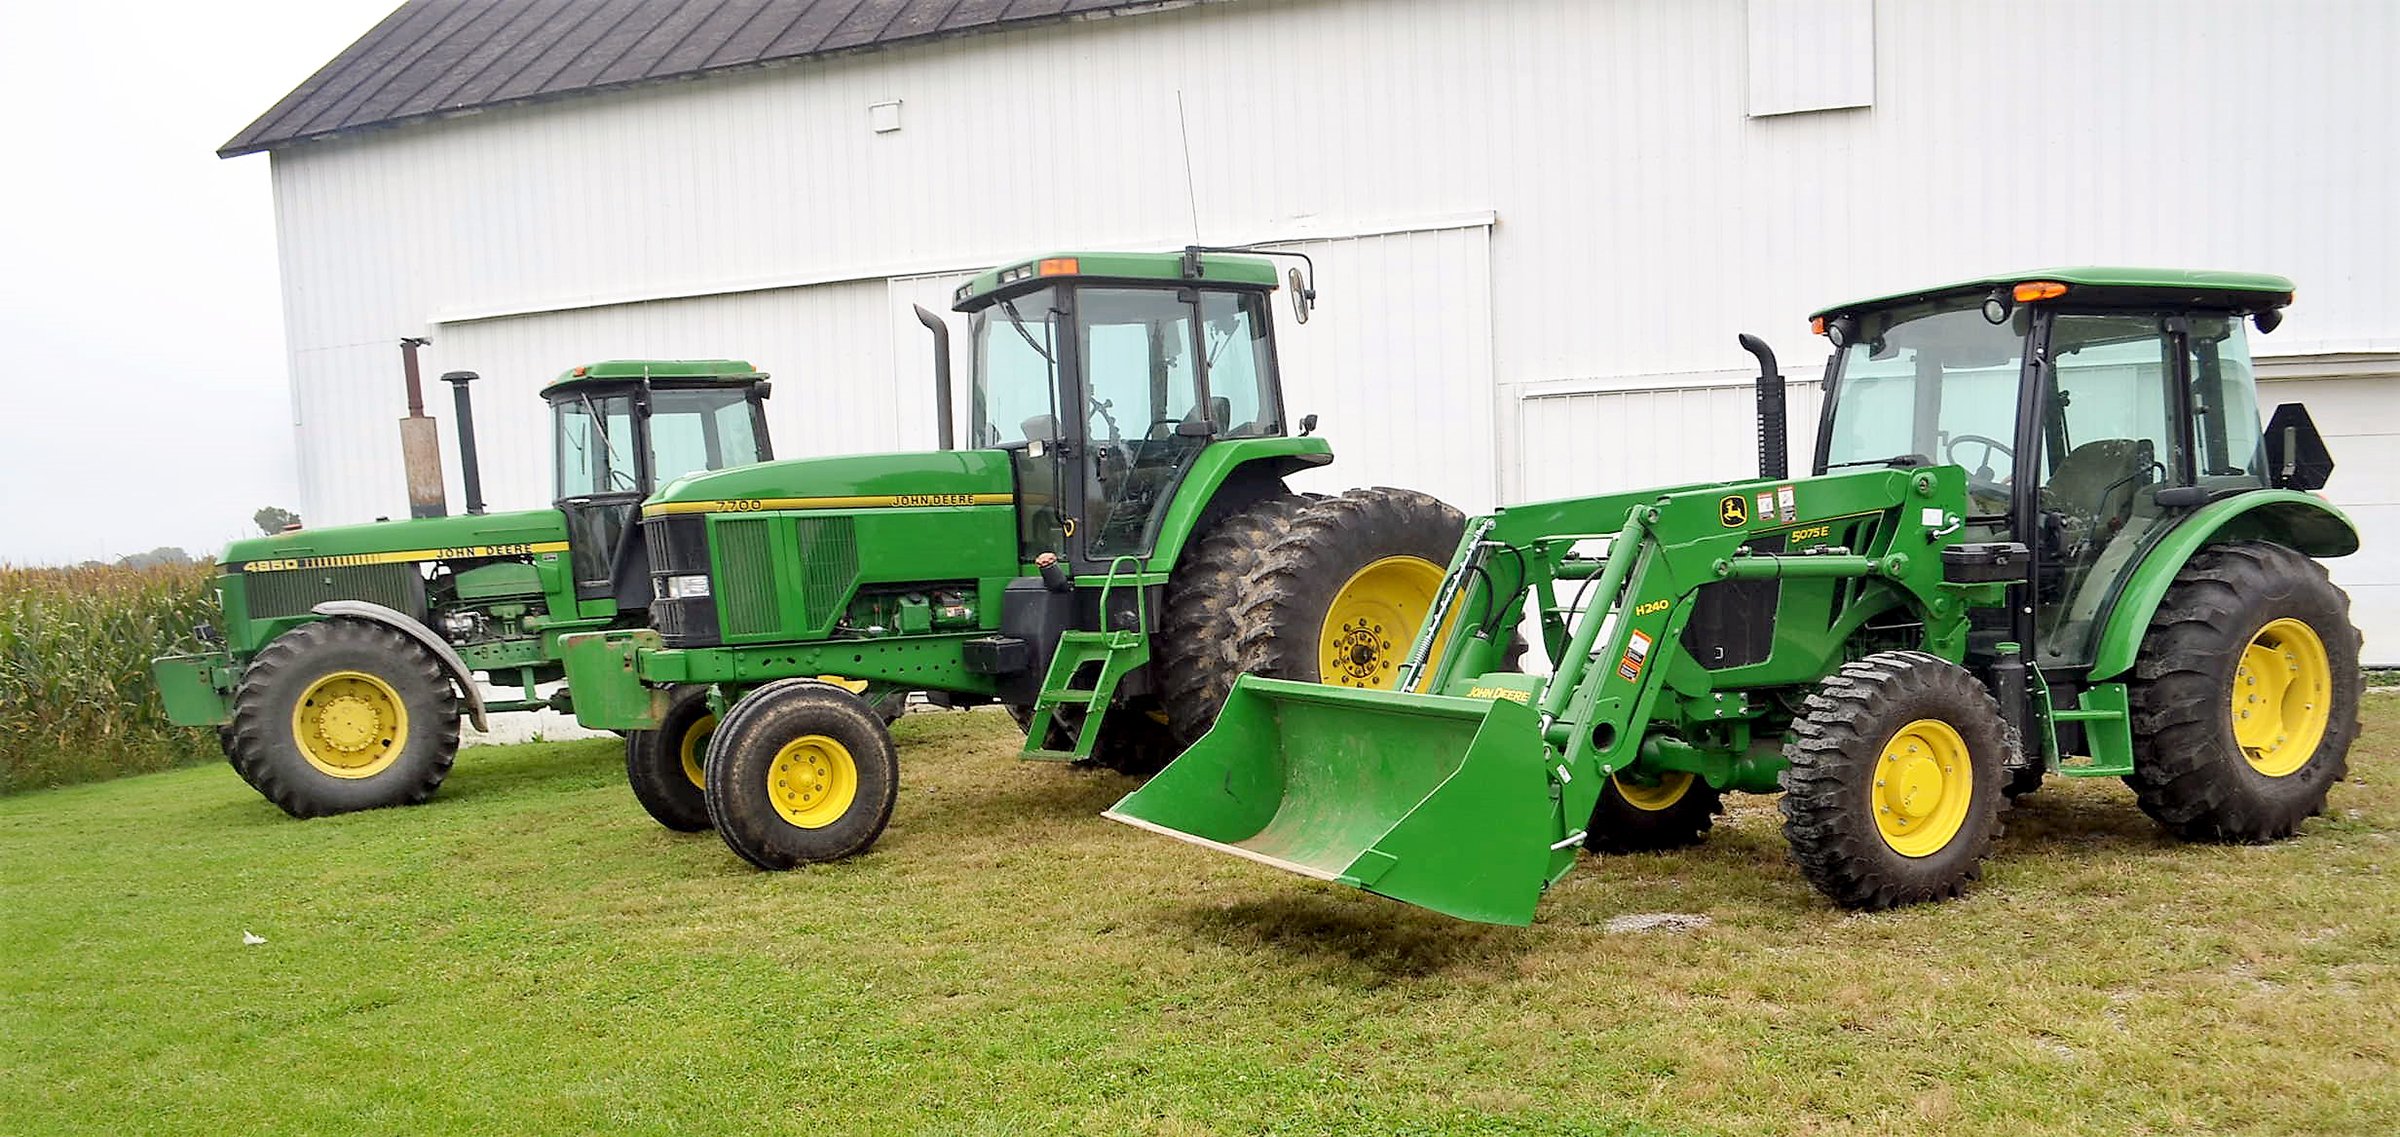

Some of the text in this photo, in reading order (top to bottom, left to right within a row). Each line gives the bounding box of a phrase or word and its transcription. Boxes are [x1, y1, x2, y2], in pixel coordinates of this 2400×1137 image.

[716, 500, 761, 511] 7700
[893, 494, 974, 506] JOHN DEERE
[1791, 526, 1829, 543] 5075E
[437, 543, 533, 559] JOHN DEERE
[1635, 599, 1669, 616] H240
[1466, 686, 1531, 703] JOHN DEERE
